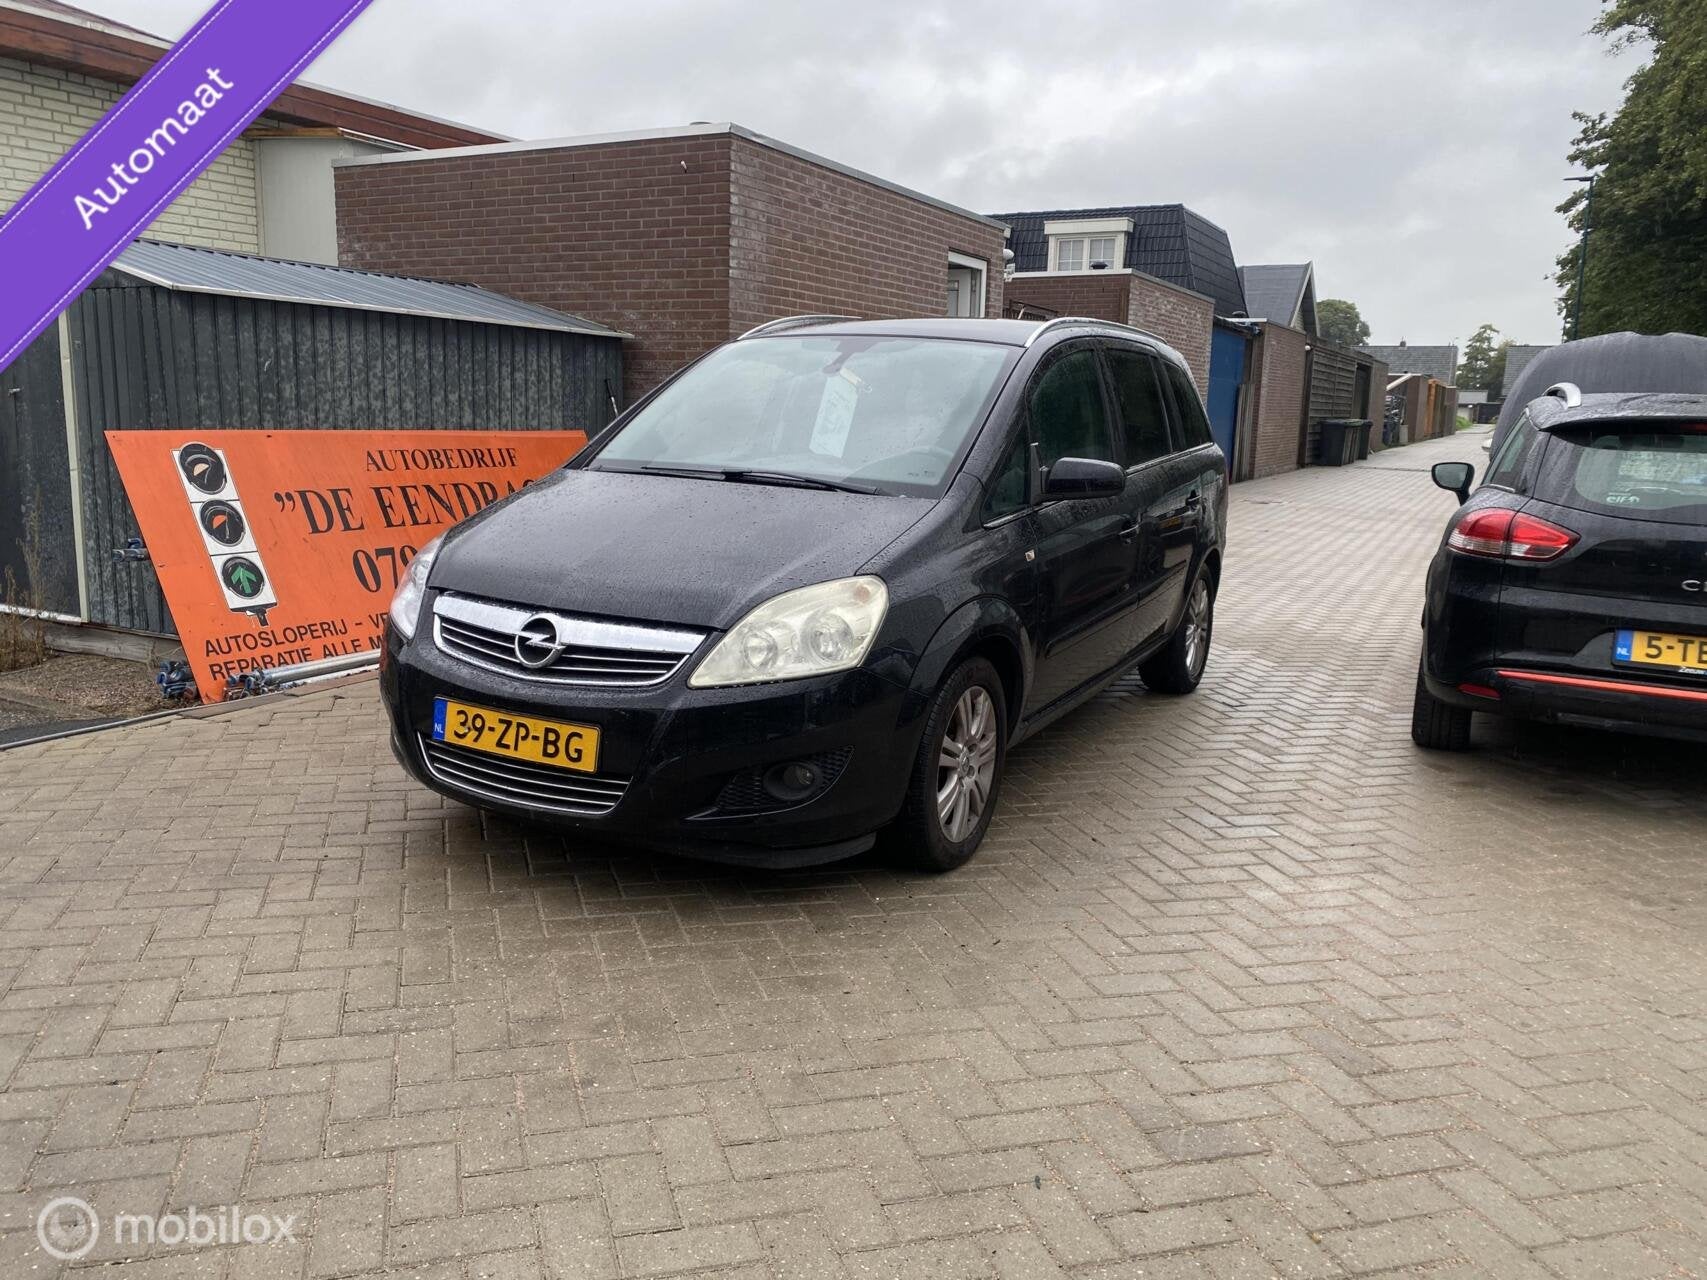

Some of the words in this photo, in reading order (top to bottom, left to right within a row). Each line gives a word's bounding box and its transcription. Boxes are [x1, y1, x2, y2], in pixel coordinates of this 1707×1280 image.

[366, 448, 519, 472] AUTOBEDRIJF
[370, 479, 536, 528] EENDR
[205, 618, 348, 657] AUTOSLOPERIJ
[209, 647, 314, 681] REPARATIE
[322, 638, 364, 659] ALLE
[434, 722, 444, 734] NL
[453, 709, 584, 764] 39-ZP-BG
